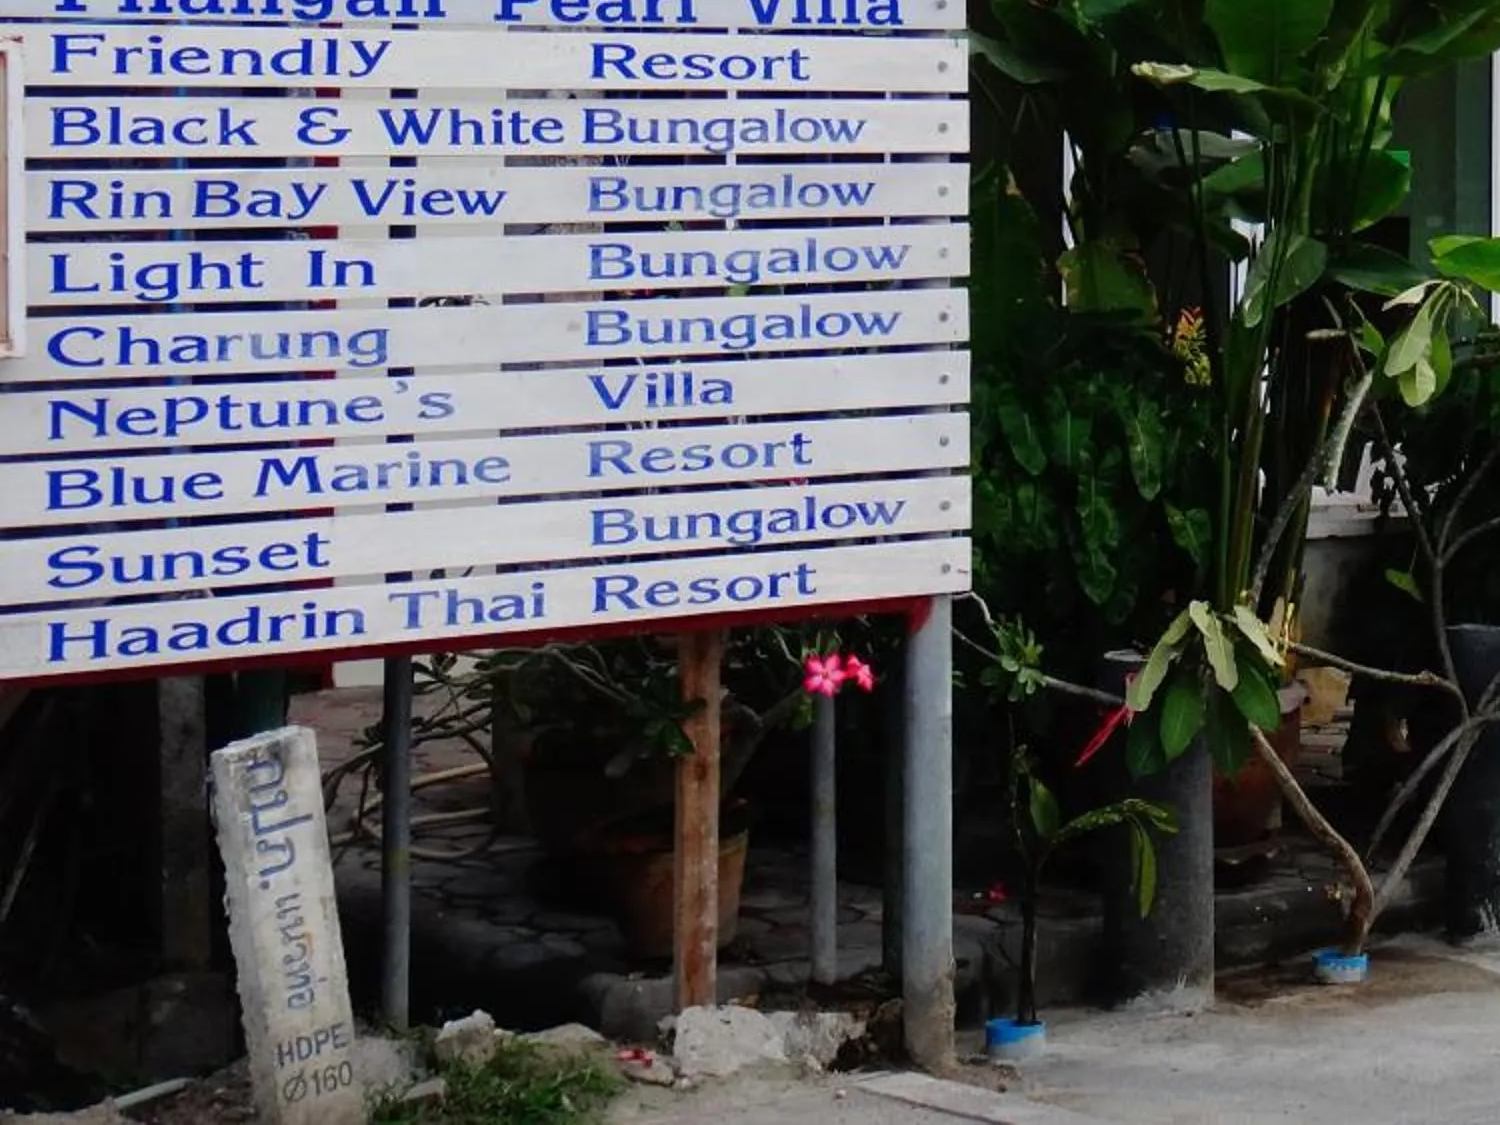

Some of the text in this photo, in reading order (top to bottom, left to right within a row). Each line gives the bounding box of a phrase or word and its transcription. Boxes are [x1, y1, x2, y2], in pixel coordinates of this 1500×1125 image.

[50, 32, 809, 83] Friendly Resort
[50, 105, 866, 154] Black & White Bungalow
[48, 174, 878, 221] Rin Bay View Bungalow
[50, 238, 910, 302] Light In Bungalow
[45, 305, 902, 368] Charung Bungalow
[587, 371, 734, 412] Villa
[45, 431, 811, 513] Blue Marine Resort
[47, 495, 905, 589] Sunset Bungalow
[46, 561, 812, 663] Haadrin Thai Resort
[275, 1022, 348, 1069] HDPE
